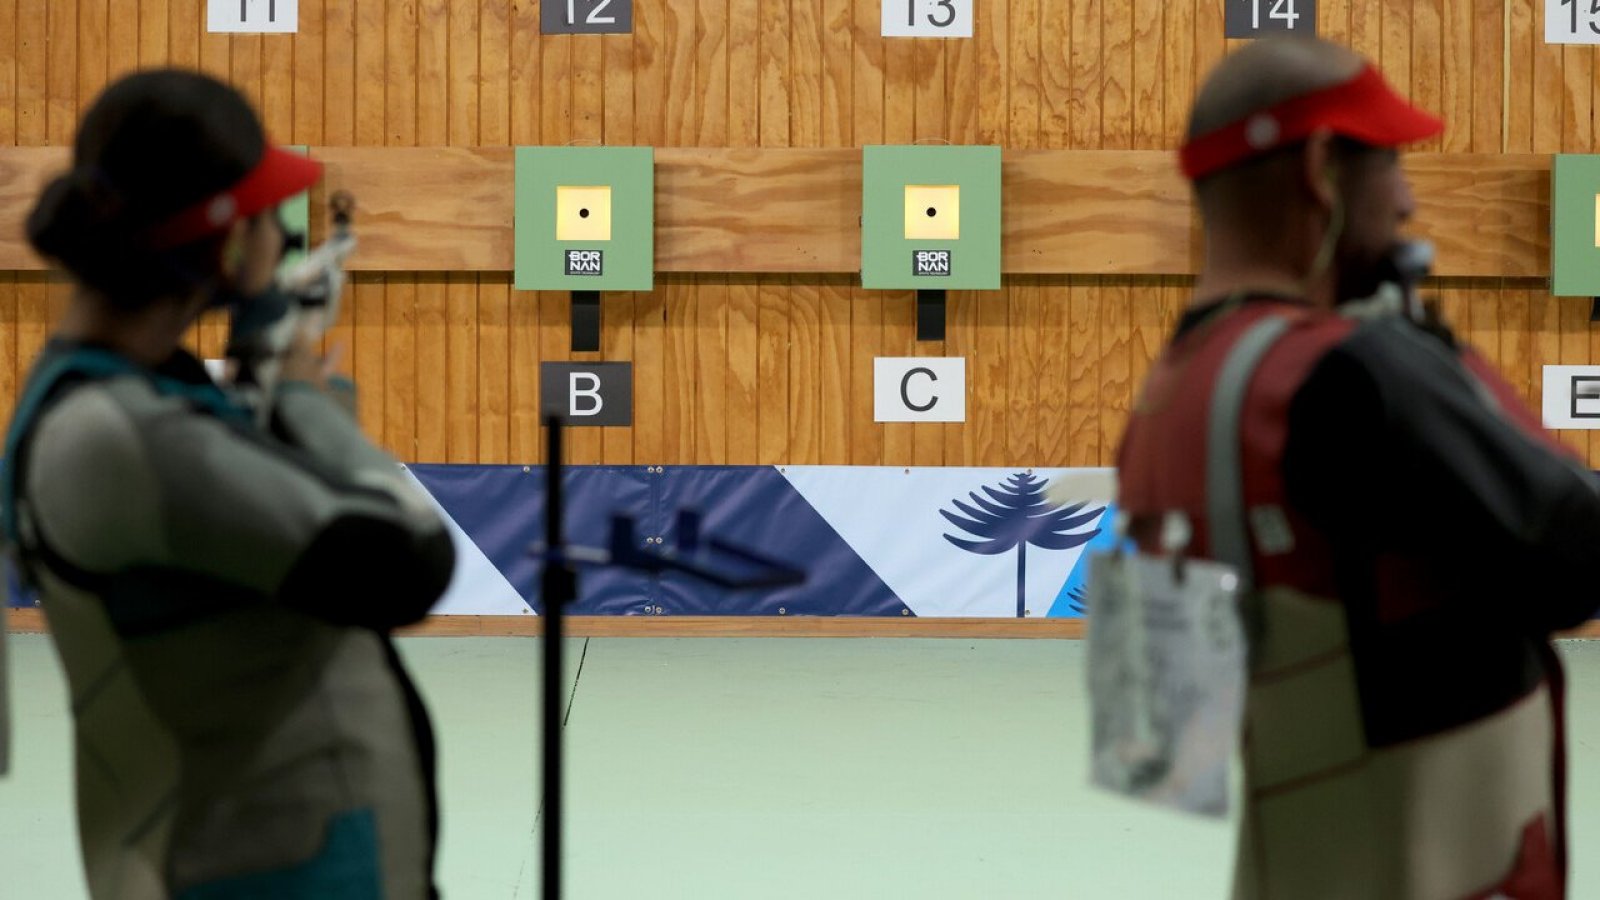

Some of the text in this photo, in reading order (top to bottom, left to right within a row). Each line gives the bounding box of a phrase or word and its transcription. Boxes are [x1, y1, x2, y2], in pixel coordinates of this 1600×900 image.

[568, 0, 615, 23] 12
[909, 0, 955, 26] 13
[1253, 0, 1299, 28] 14
[570, 373, 602, 415] B
[901, 368, 938, 411] C
[1571, 376, 1600, 418] E
